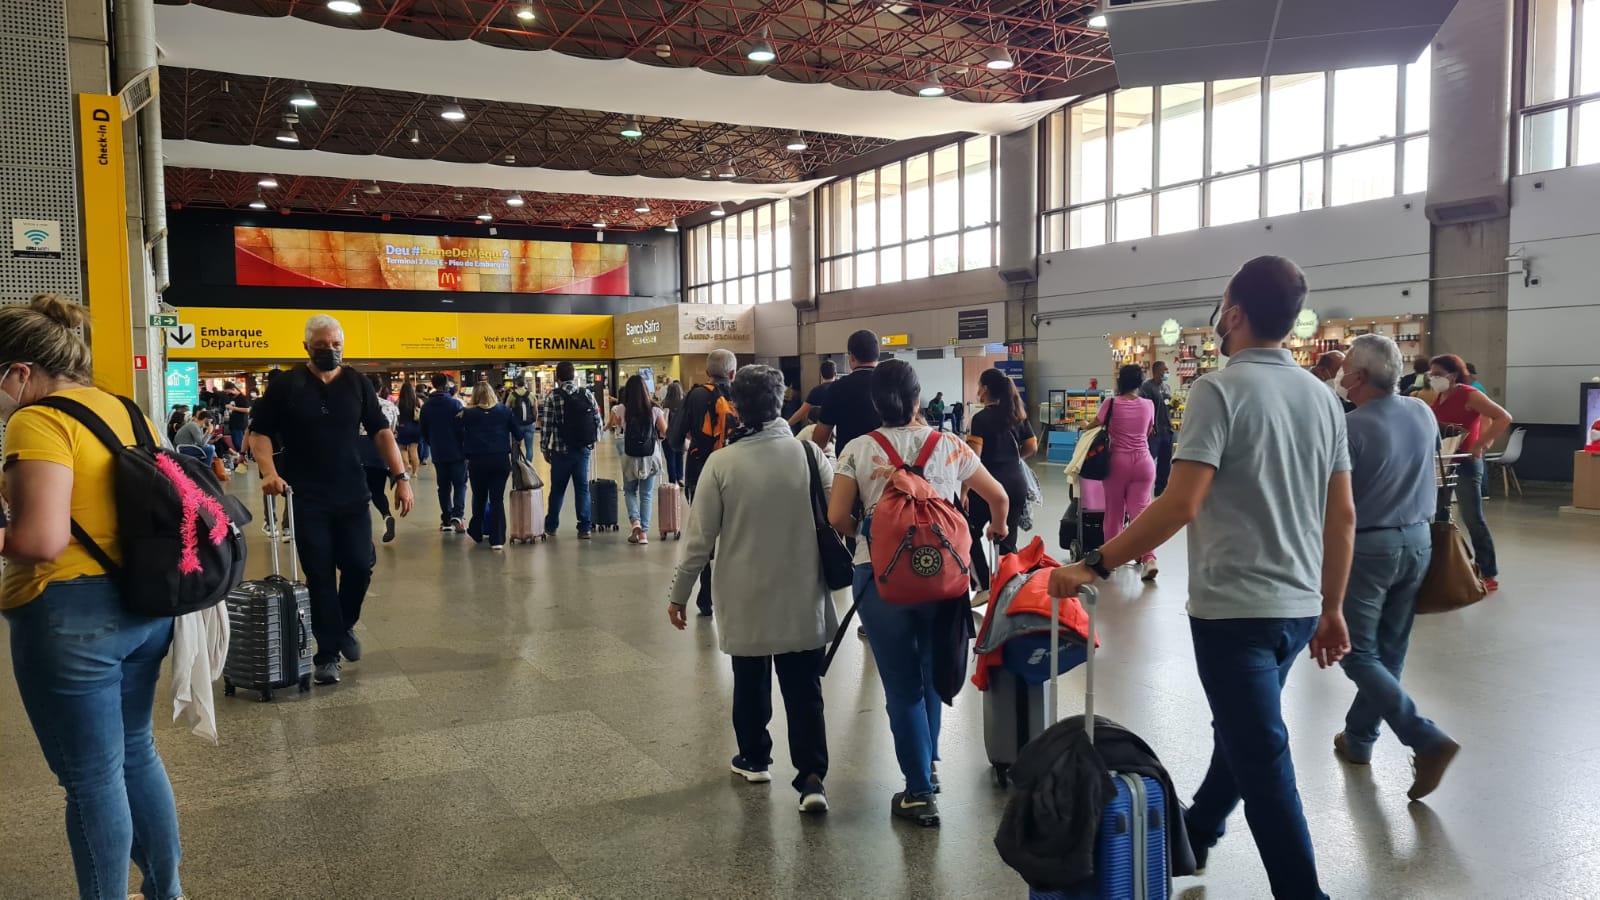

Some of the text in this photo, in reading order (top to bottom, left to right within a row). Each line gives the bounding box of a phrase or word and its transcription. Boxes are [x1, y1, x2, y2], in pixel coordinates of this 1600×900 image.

[93, 109, 110, 165] Check-in D
[385, 245, 409, 256] Deu
[386, 257, 417, 265] Terminal
[449, 259, 464, 267] Piso
[475, 260, 509, 269] Embarque
[625, 319, 660, 336] Banco Safra
[695, 316, 738, 331] Safra
[201, 327, 262, 338] Embarque
[201, 338, 269, 350] Departures
[527, 337, 607, 350] TERMINAL 2
